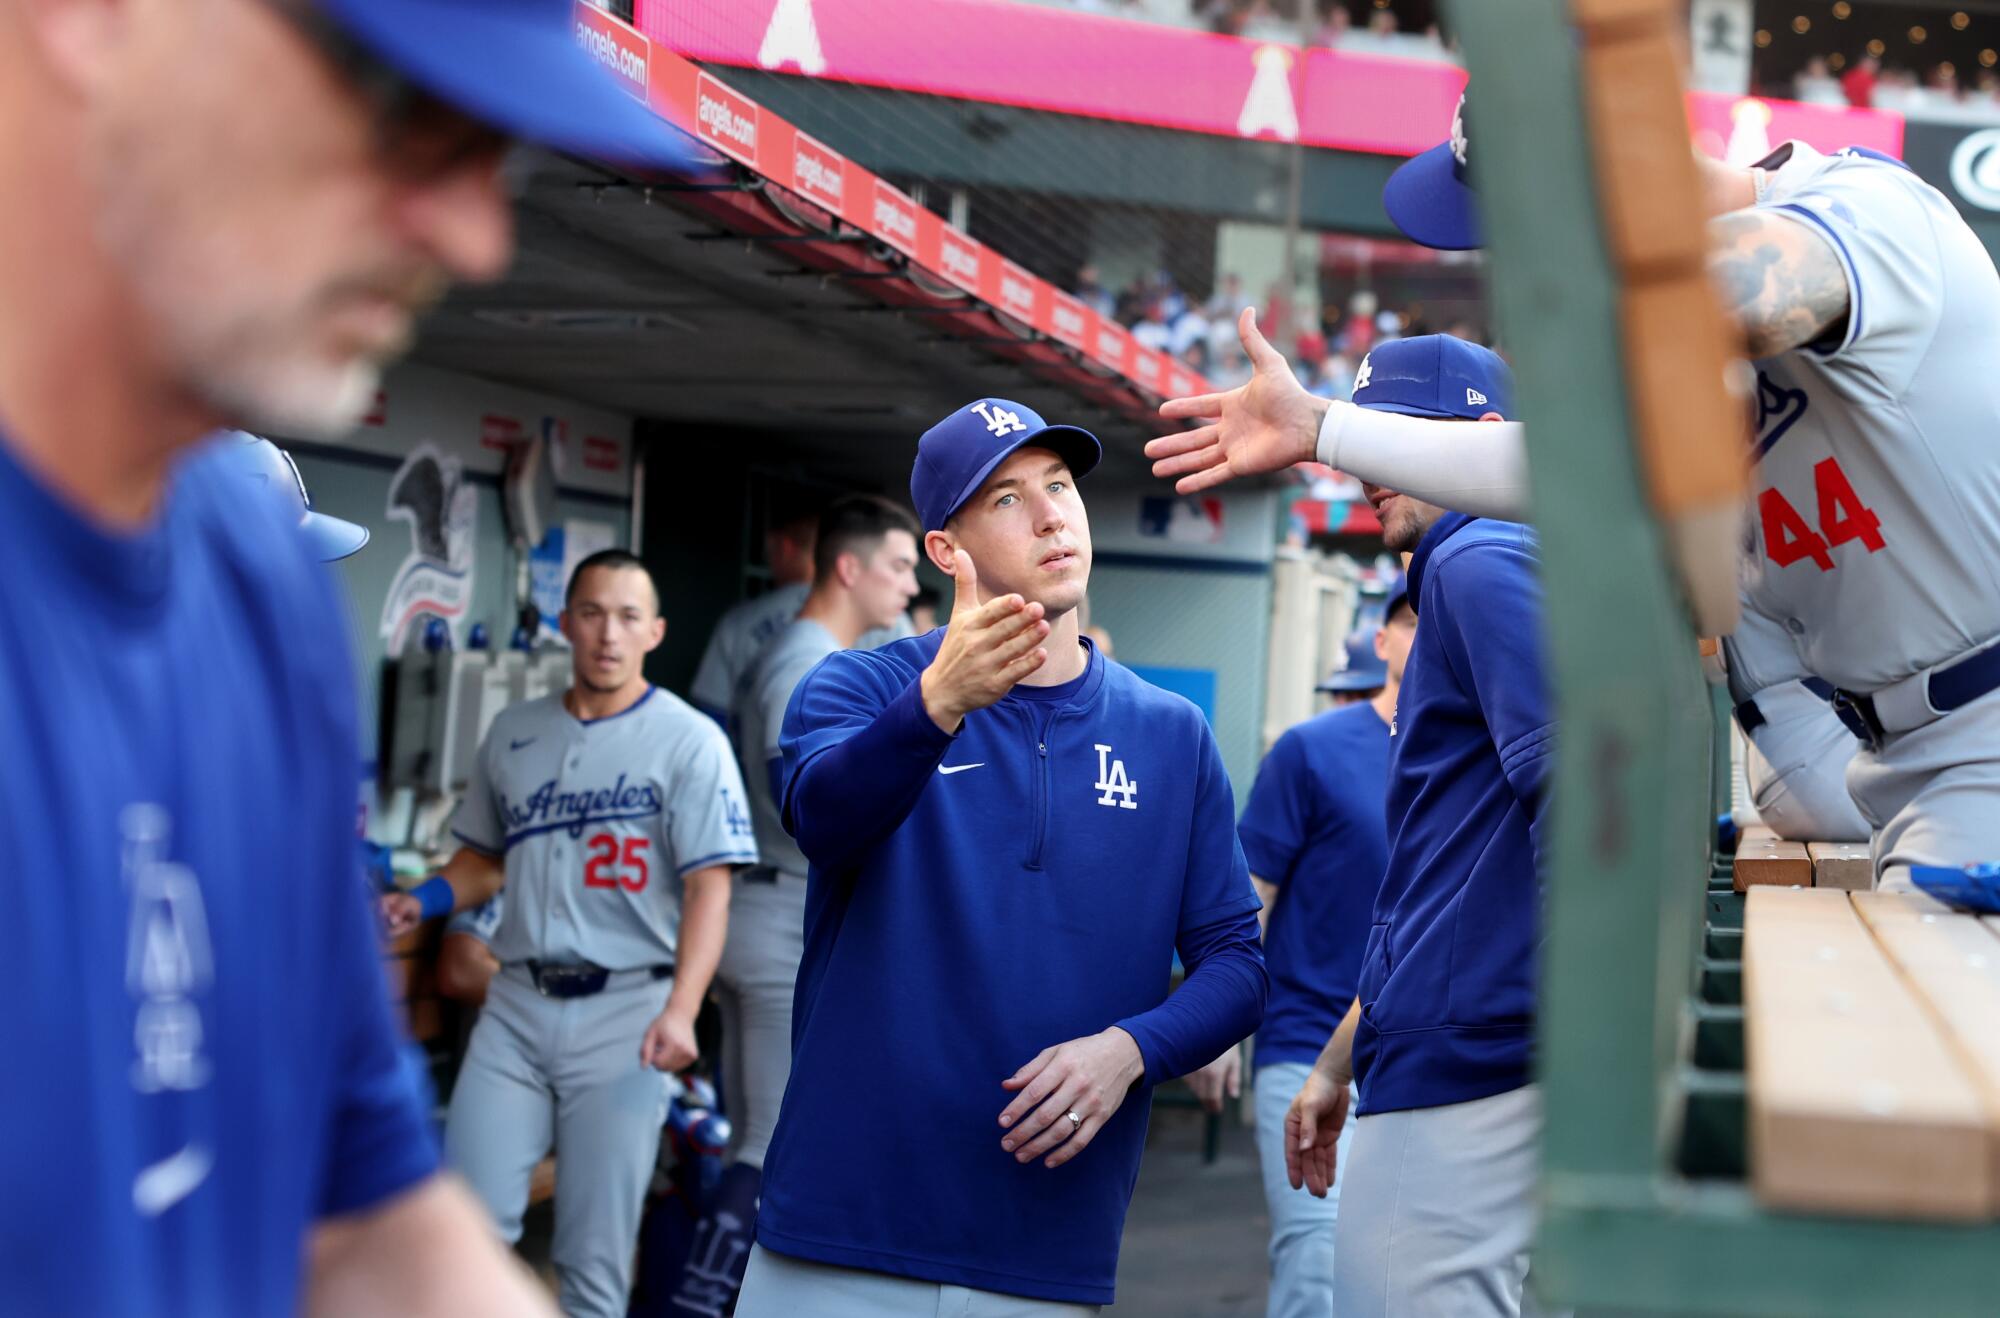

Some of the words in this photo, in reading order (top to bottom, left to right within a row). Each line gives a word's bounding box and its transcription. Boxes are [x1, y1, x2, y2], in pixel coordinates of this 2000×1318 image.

[576, 22, 646, 87] angels.com
[699, 93, 755, 149] angels.com
[970, 402, 1027, 438] LA
[1758, 456, 1887, 572] 44
[1094, 744, 1138, 810] LA
[583, 832, 651, 894] 25
